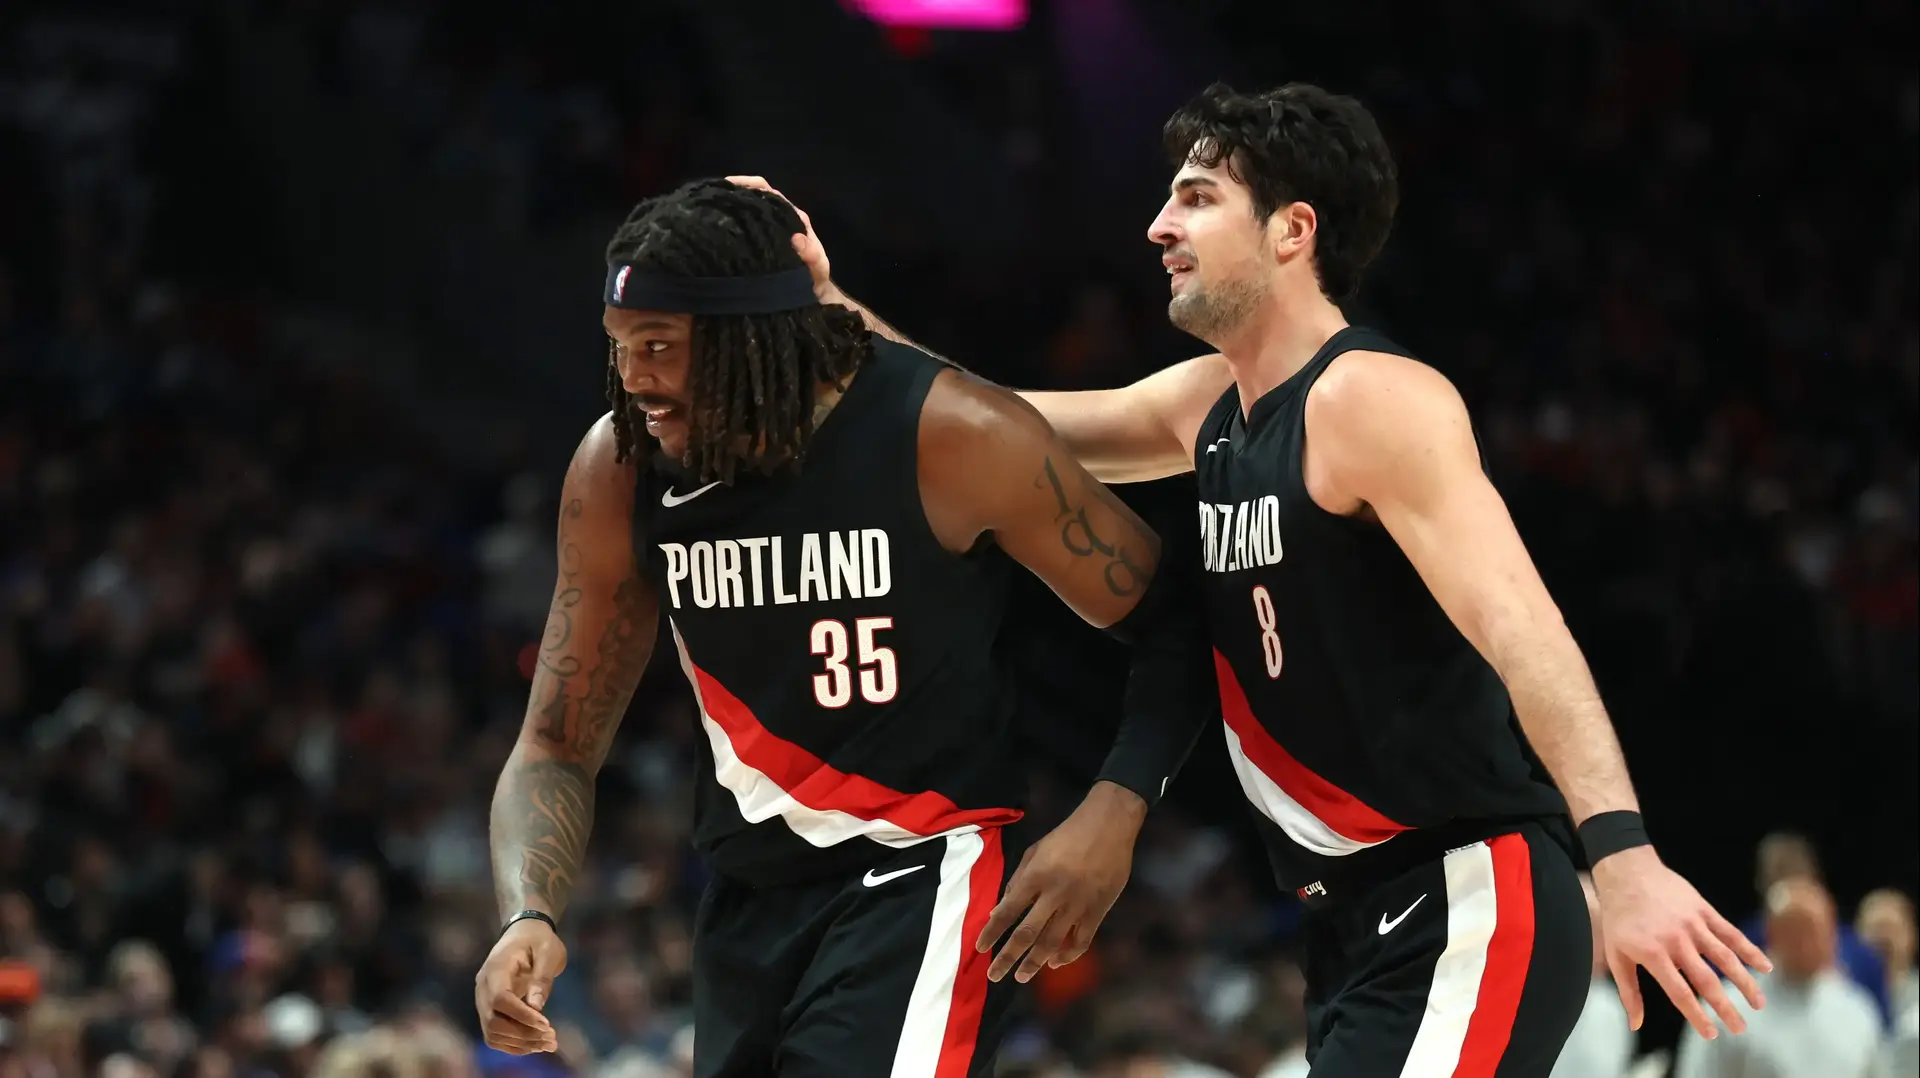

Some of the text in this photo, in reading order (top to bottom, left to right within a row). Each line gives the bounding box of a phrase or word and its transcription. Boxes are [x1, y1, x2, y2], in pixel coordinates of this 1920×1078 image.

[657, 528, 892, 609] PORTLAND
[808, 616, 900, 710] 35
[1252, 584, 1284, 680] 8
